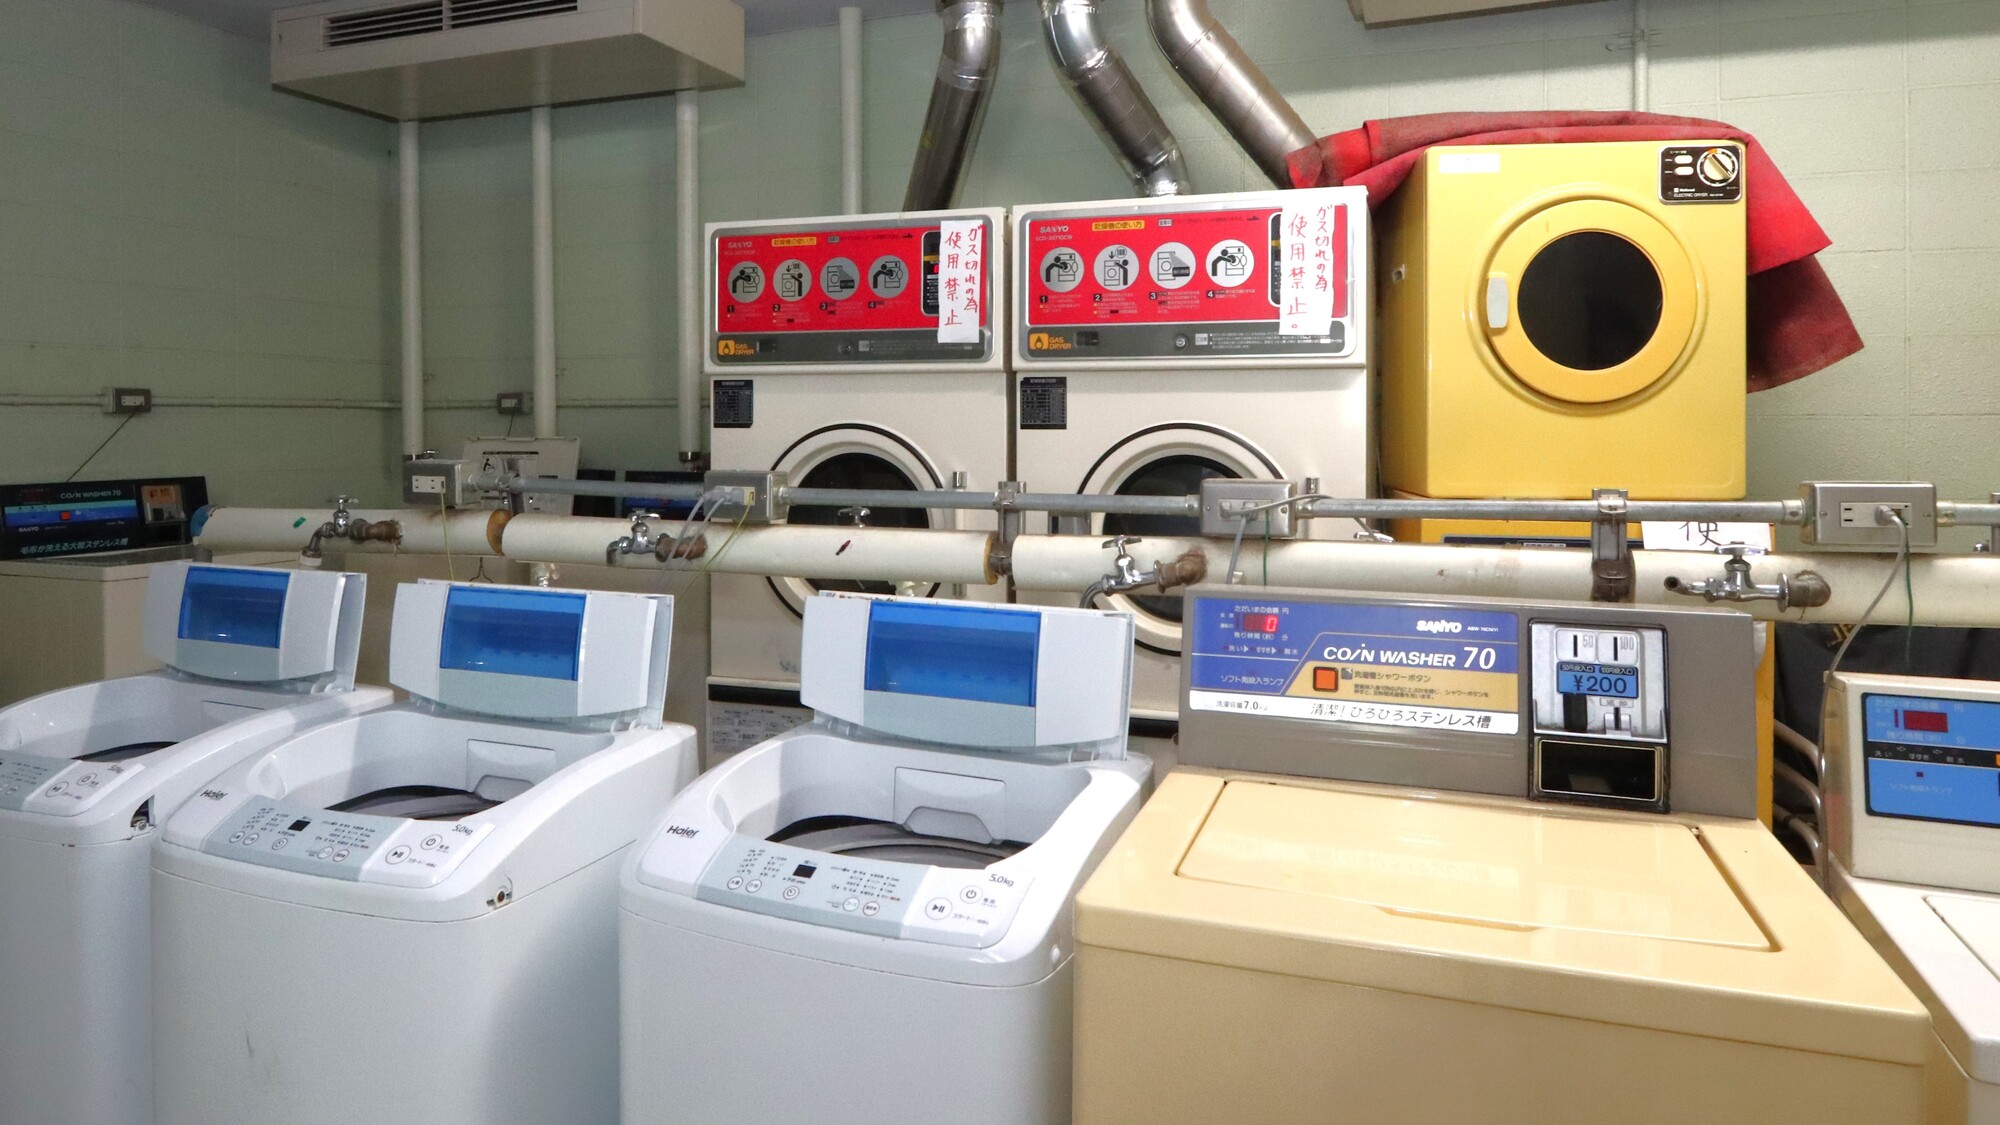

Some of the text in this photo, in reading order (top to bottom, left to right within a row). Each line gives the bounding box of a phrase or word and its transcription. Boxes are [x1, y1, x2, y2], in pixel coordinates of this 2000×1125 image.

[1040, 225, 1069, 234] SANYO
[112, 489, 122, 497] 70
[1266, 617, 1278, 632] 0
[1416, 620, 1462, 633] SANYO
[1582, 635, 1594, 649] 50
[1619, 637, 1635, 651] 100
[1380, 650, 1456, 668] WASHER
[1463, 646, 1496, 669] 70
[1573, 675, 1627, 694] ¥200
[200, 789, 228, 800] Haier
[666, 825, 700, 838] Haier
[988, 873, 1015, 887] 5.0kg
